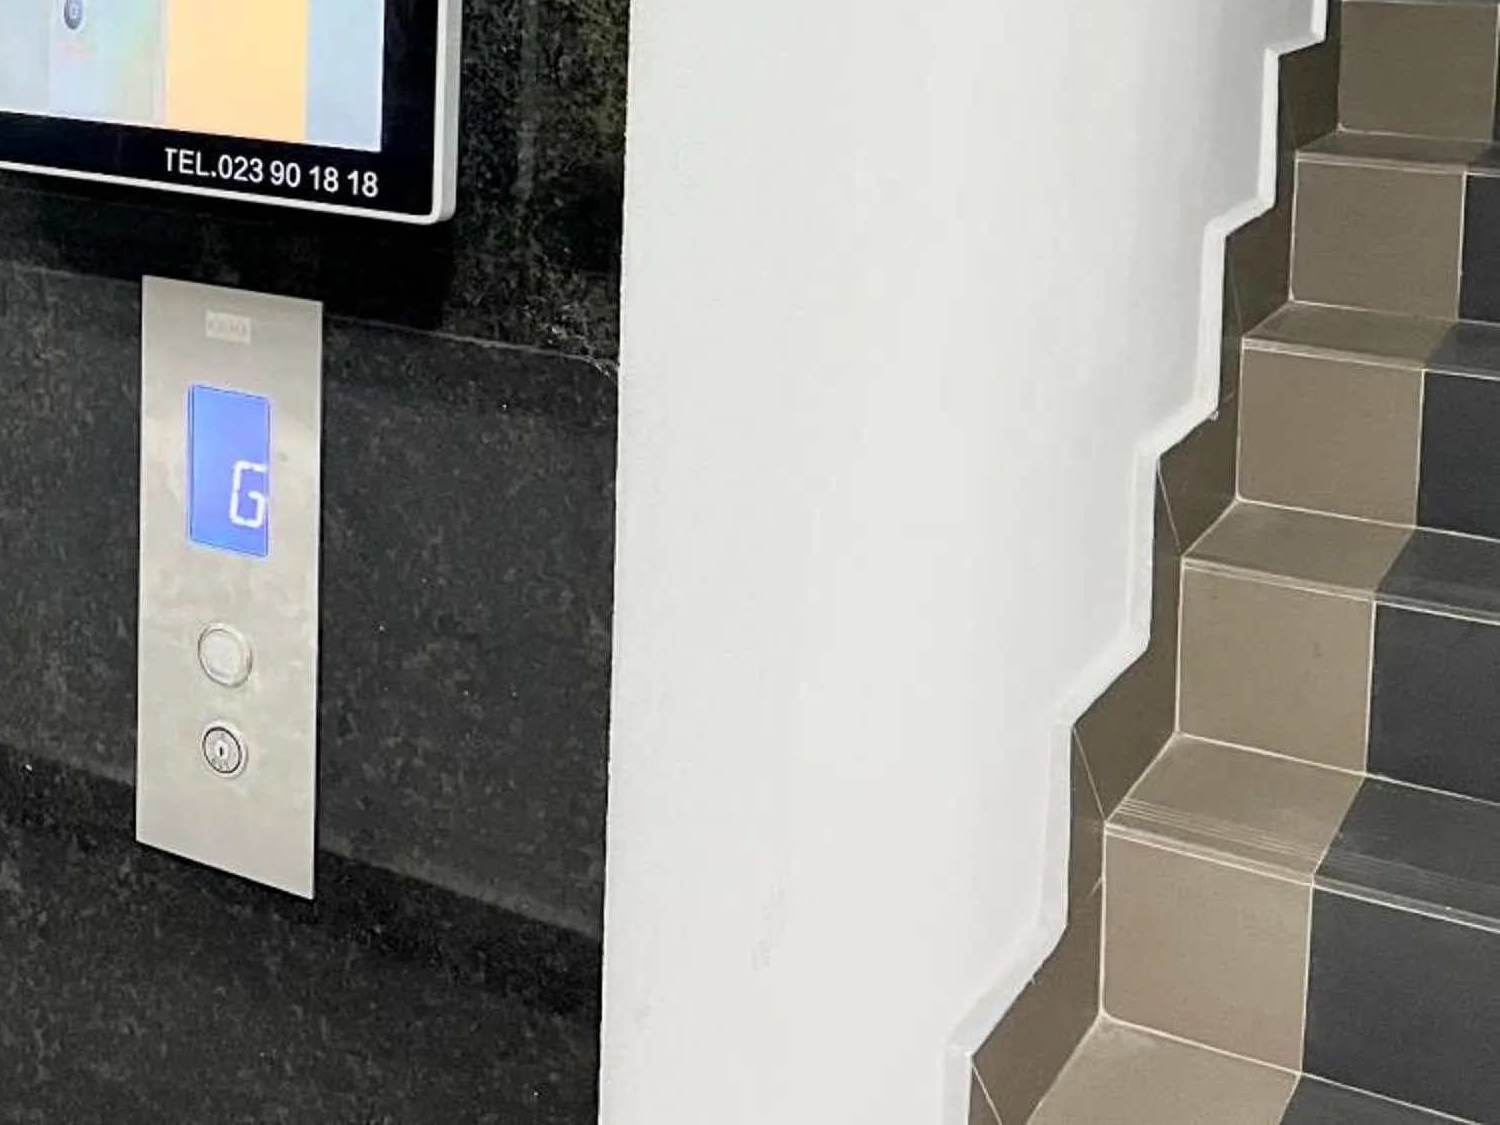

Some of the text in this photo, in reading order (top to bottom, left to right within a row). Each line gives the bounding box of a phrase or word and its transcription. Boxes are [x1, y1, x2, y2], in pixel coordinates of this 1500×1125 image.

[164, 147, 379, 198] TEL.023 90 18 18
[229, 458, 268, 529] G
